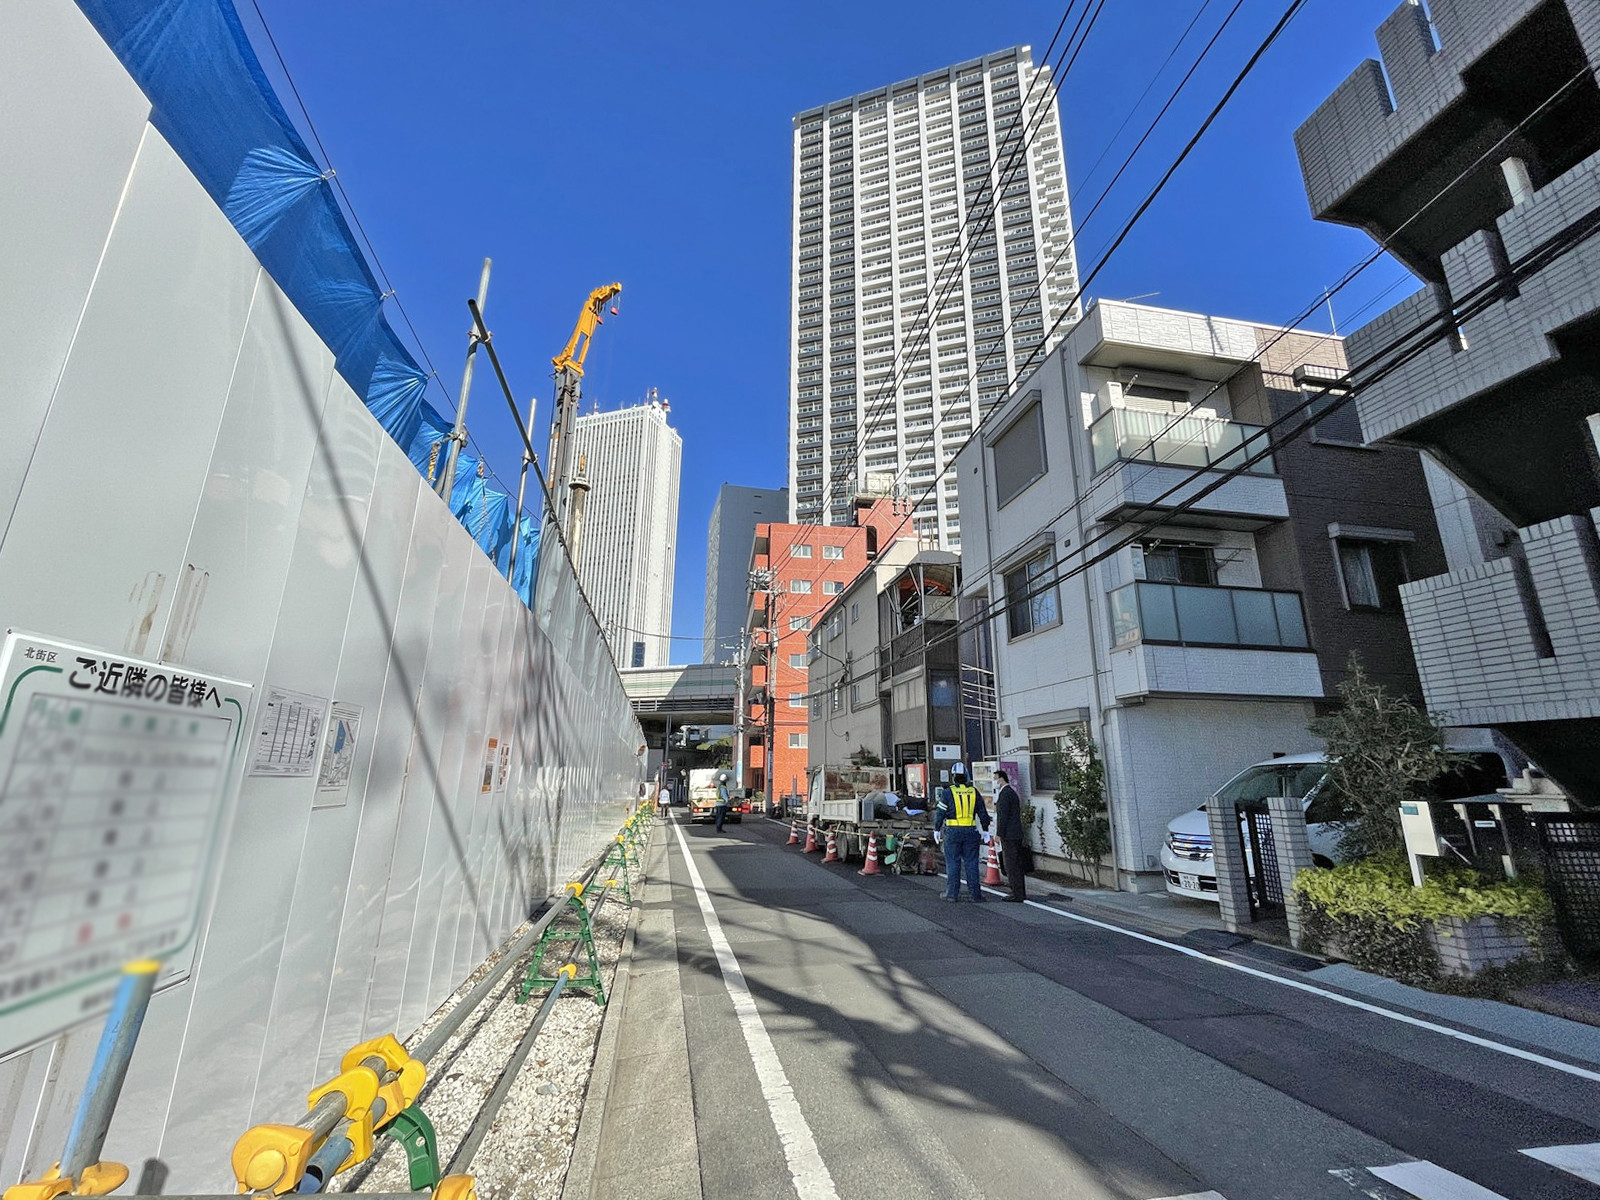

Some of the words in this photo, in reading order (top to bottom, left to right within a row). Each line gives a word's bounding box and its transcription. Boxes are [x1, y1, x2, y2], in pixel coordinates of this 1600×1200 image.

[24, 646, 59, 663] 北街区
[68, 656, 222, 708] ご近隣の皆様へ
